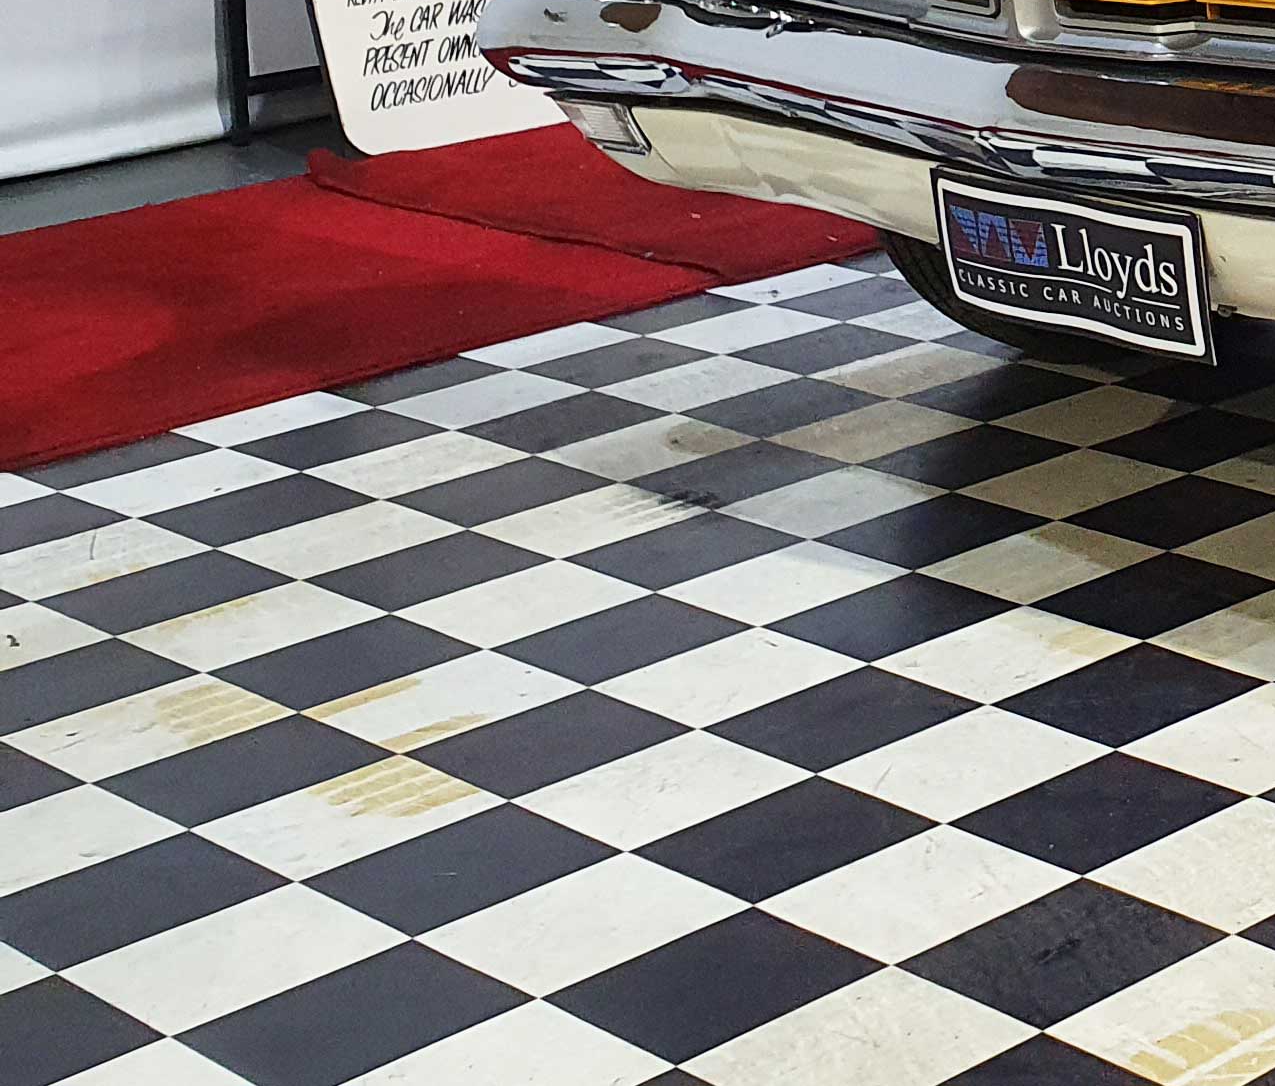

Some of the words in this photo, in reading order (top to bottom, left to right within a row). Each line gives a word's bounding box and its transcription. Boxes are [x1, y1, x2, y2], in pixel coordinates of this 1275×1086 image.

[370, 10, 406, 41] The
[410, 2, 444, 32] CAR
[363, 39, 435, 76] PRESENT
[371, 66, 497, 111] OCCASIONALLY
[1051, 222, 1178, 299] Lloyds
[958, 268, 1029, 298] CLASSIC
[1043, 286, 1082, 305] CAR
[1093, 295, 1185, 331] AUCTIONS
